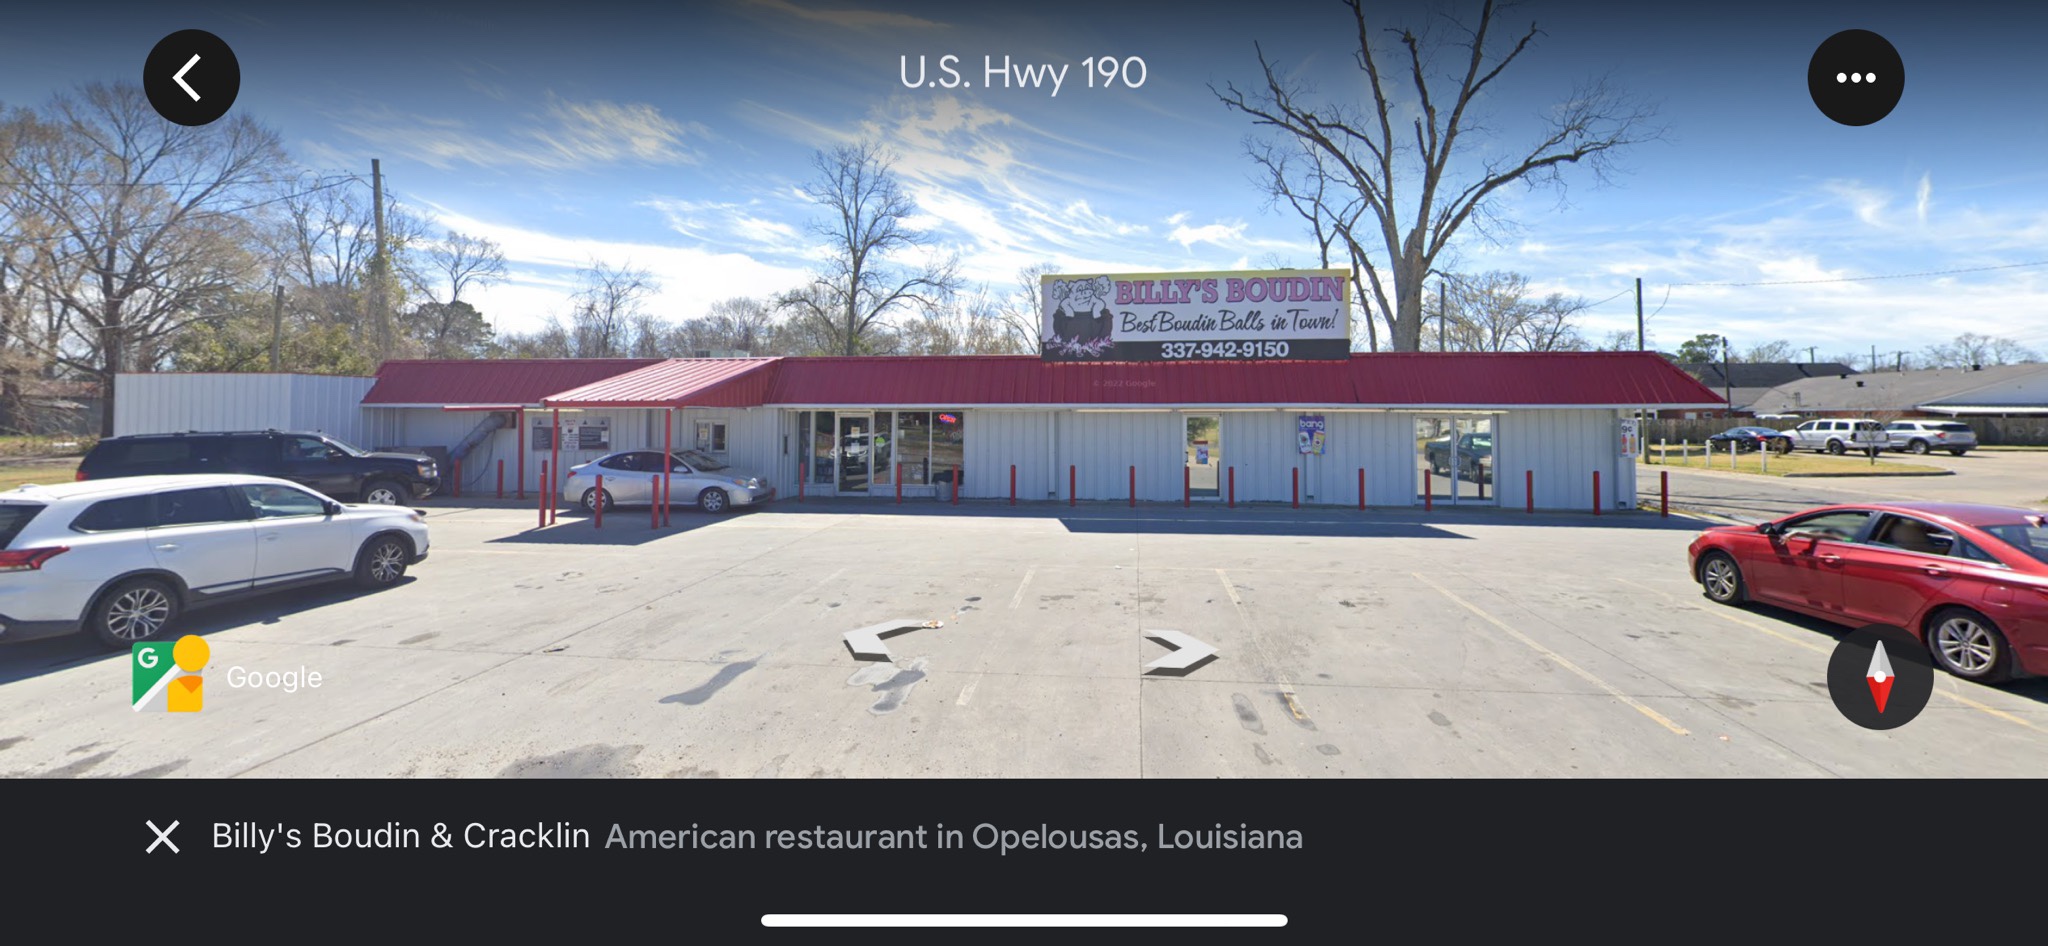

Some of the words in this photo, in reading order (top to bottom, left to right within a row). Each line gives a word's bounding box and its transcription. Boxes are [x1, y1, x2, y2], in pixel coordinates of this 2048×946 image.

[1115, 278, 1219, 305] BILLY'S
[1225, 276, 1345, 303] BOUDIN
[1119, 311, 1158, 334] Best
[1157, 310, 1217, 332] Boudin
[1218, 308, 1266, 332] Balls
[1270, 314, 1288, 331] in
[1286, 307, 1340, 332] Town!
[1161, 340, 1290, 359] 337-942-9150
[1299, 419, 1324, 430] bang
